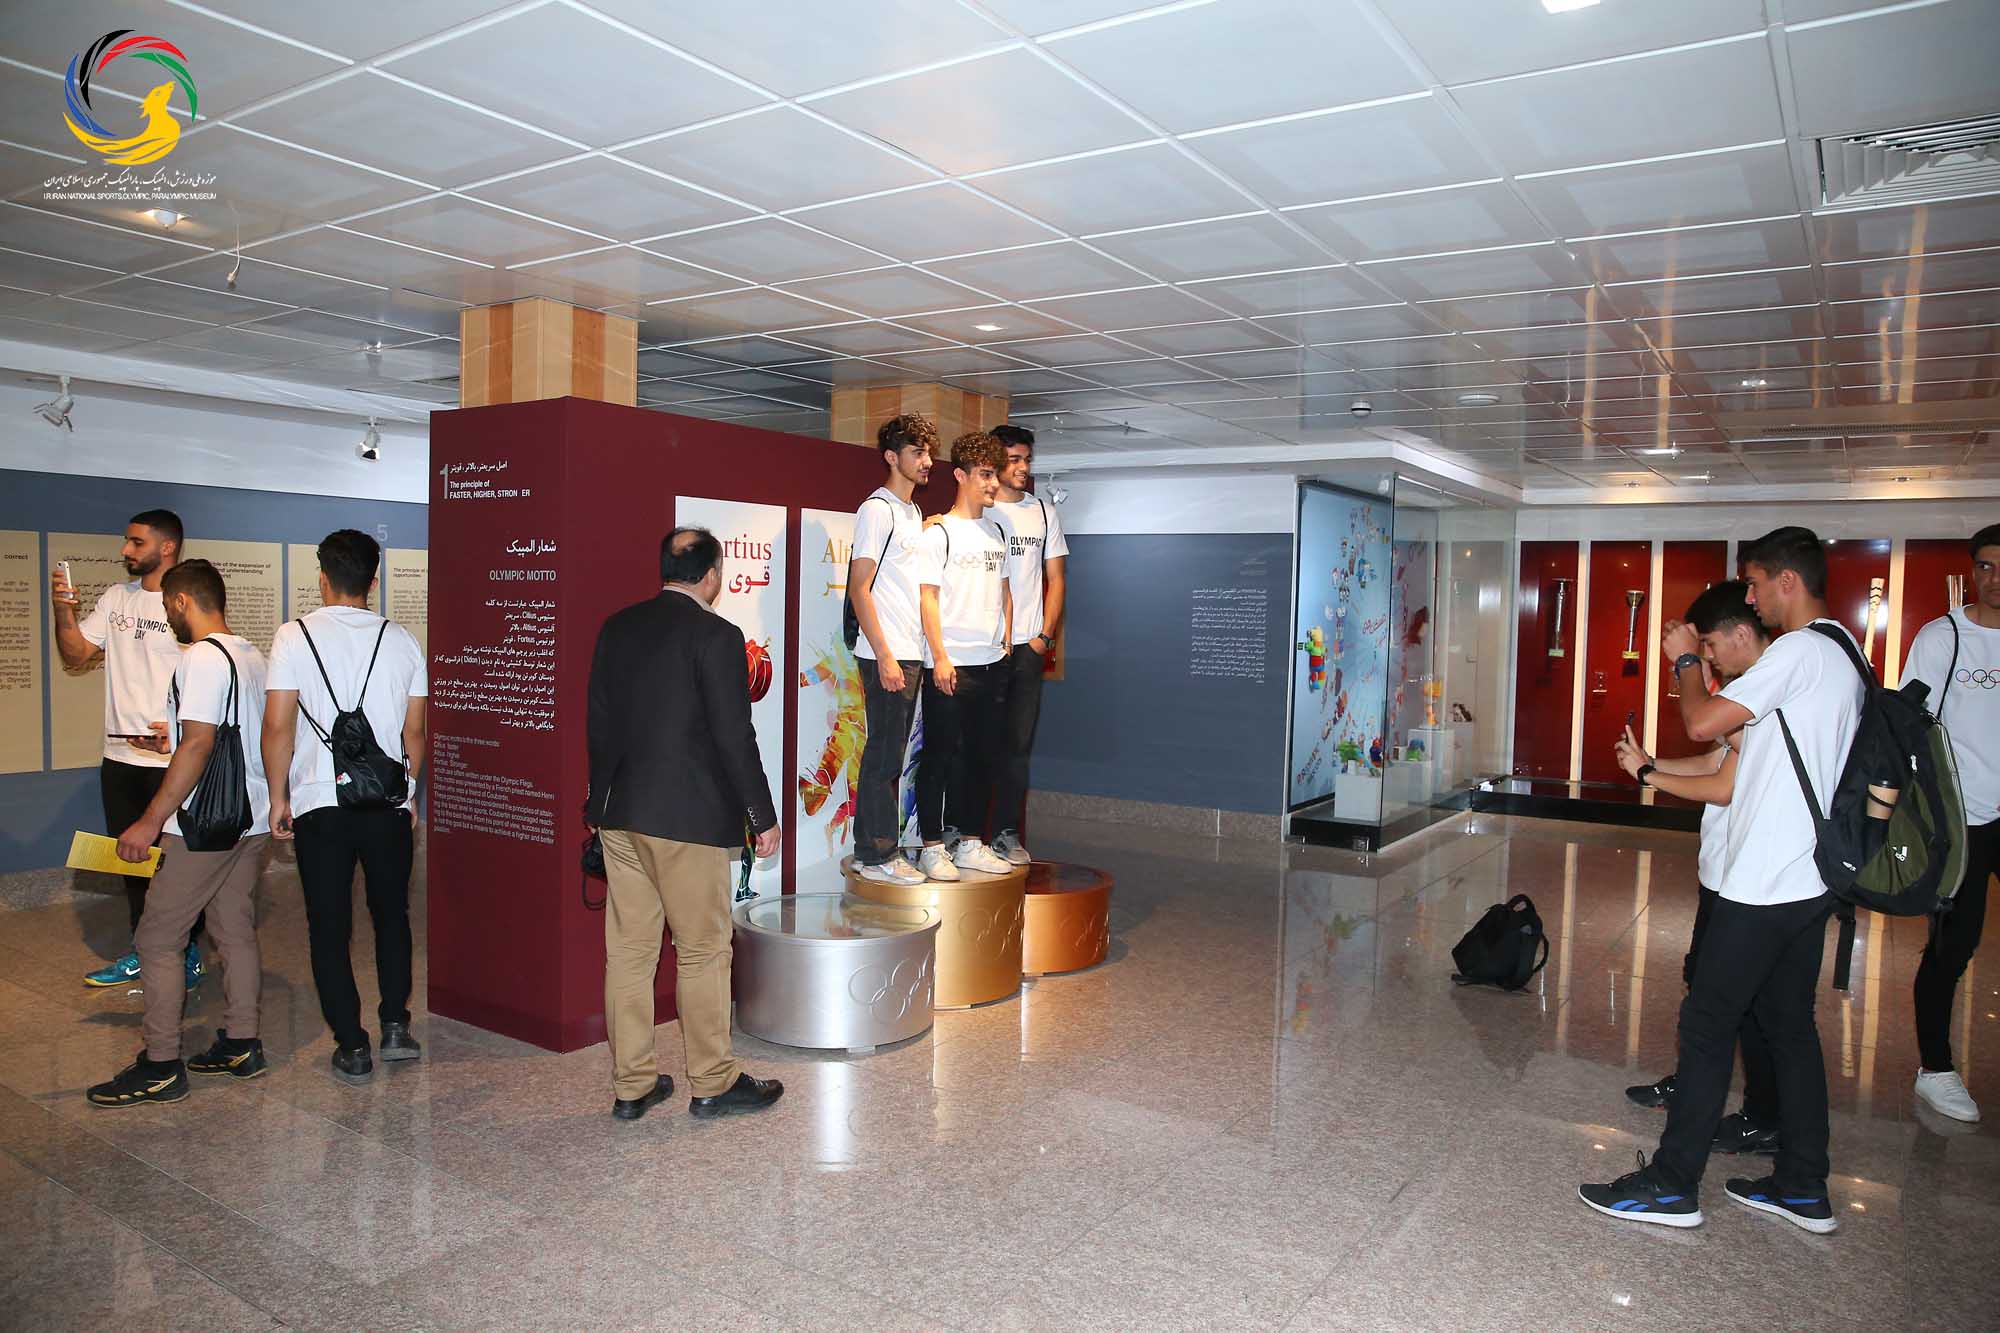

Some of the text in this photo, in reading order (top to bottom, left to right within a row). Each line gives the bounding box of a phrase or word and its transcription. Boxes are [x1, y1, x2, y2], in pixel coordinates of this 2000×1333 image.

[496, 460, 507, 472] اصل
[461, 480, 483, 489] principle
[450, 491, 472, 499] FASTER,
[473, 490, 496, 499] HIGHER,
[377, 524, 388, 541] 5
[1011, 536, 1041, 547] OLYMPIC
[506, 539, 556, 558] شعار المپیک
[723, 534, 850, 564] rtius Alt
[1011, 547, 1026, 556] DAY
[984, 551, 1005, 560] OLYMP
[985, 562, 996, 572] DAY
[490, 570, 556, 581] OLYMPIC MOTTO
[729, 566, 770, 593] قوی
[529, 600, 544, 610] المپیک
[545, 600, 555, 608] شعار
[137, 618, 168, 633] OLYMPIC
[135, 630, 146, 640] DAY
[536, 661, 546, 669] شعار
